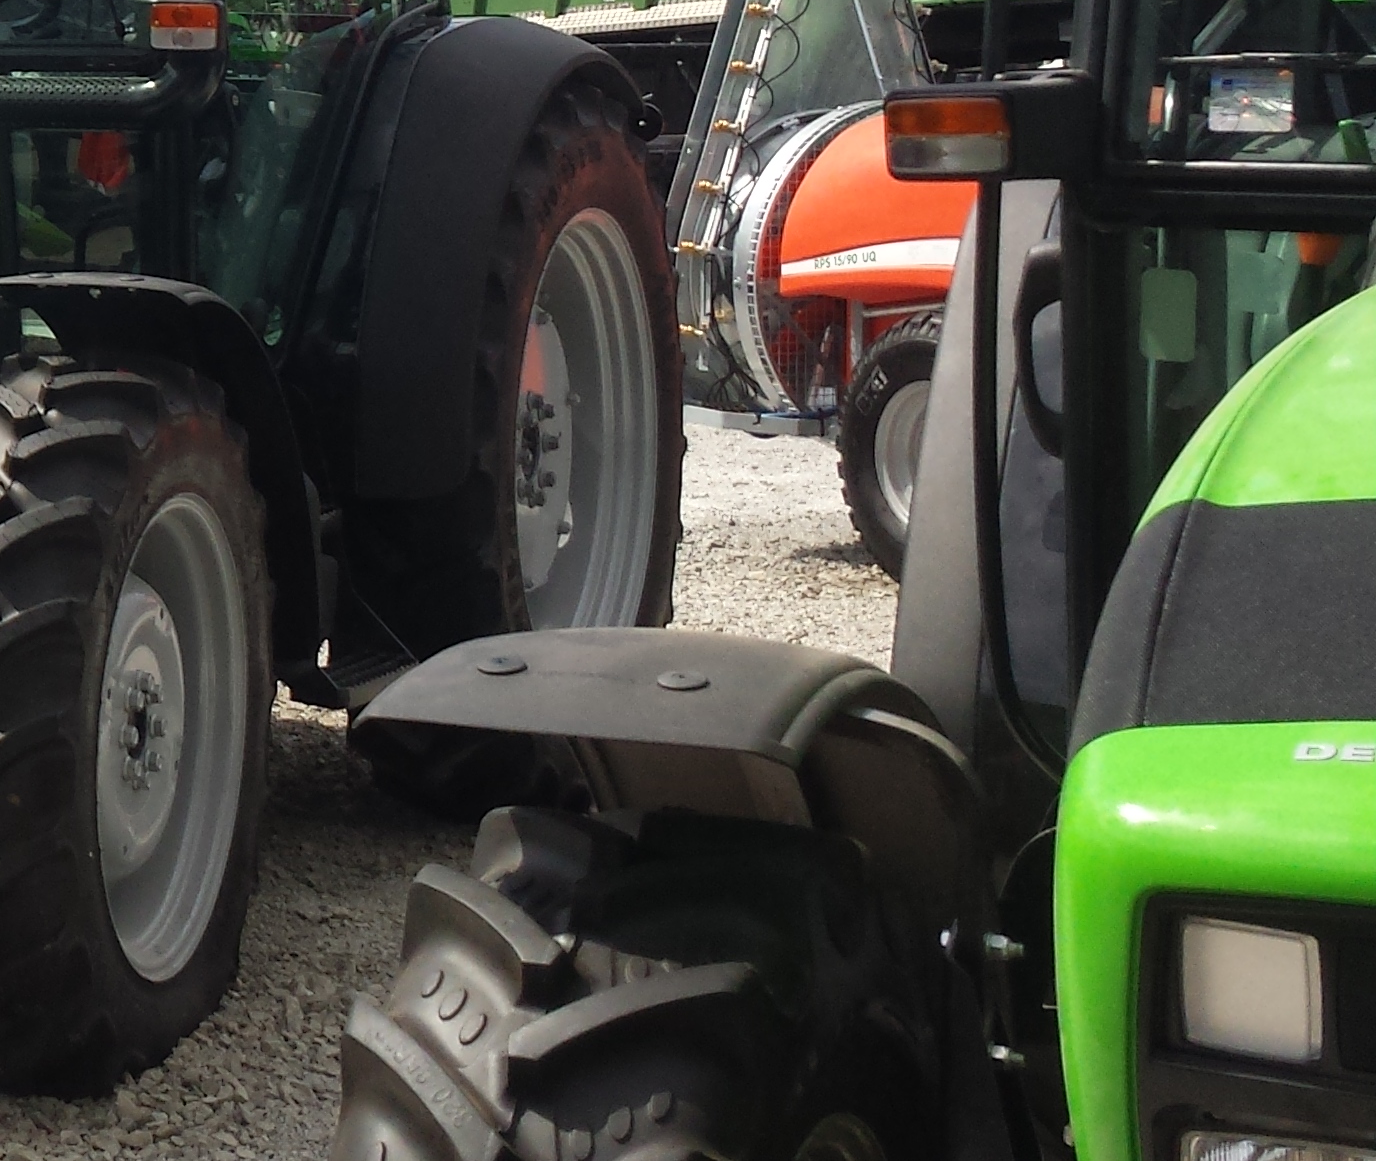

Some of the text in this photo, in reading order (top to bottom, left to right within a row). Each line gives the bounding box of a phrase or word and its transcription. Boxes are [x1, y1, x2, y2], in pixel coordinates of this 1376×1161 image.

[814, 250, 877, 270] RPS 15/90 UQ
